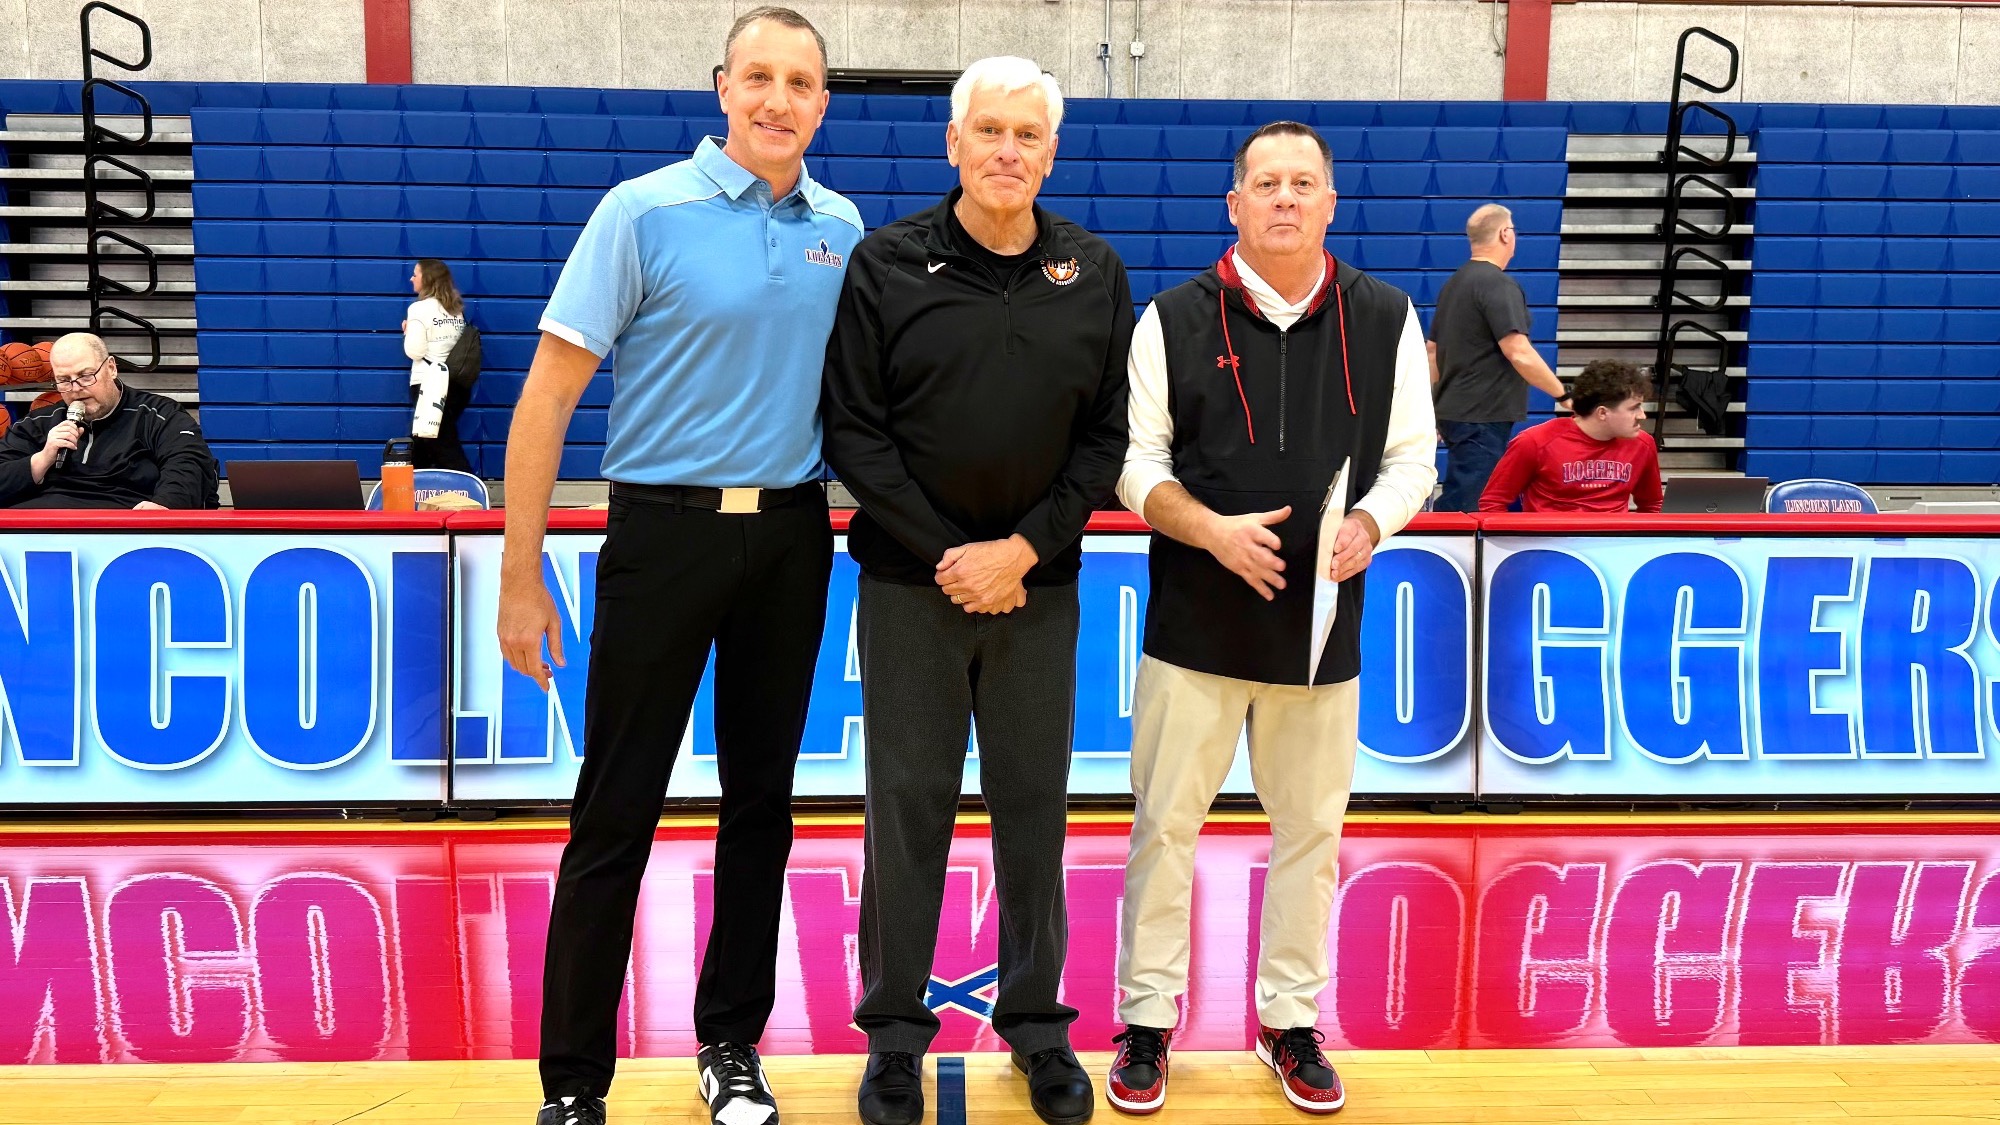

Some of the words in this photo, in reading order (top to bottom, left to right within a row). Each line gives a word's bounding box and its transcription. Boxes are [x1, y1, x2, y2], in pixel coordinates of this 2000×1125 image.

[1563, 460, 1632, 483] LOGGERS
[1784, 500, 1829, 513] LINCOLN
[1831, 500, 1862, 513] LAND
